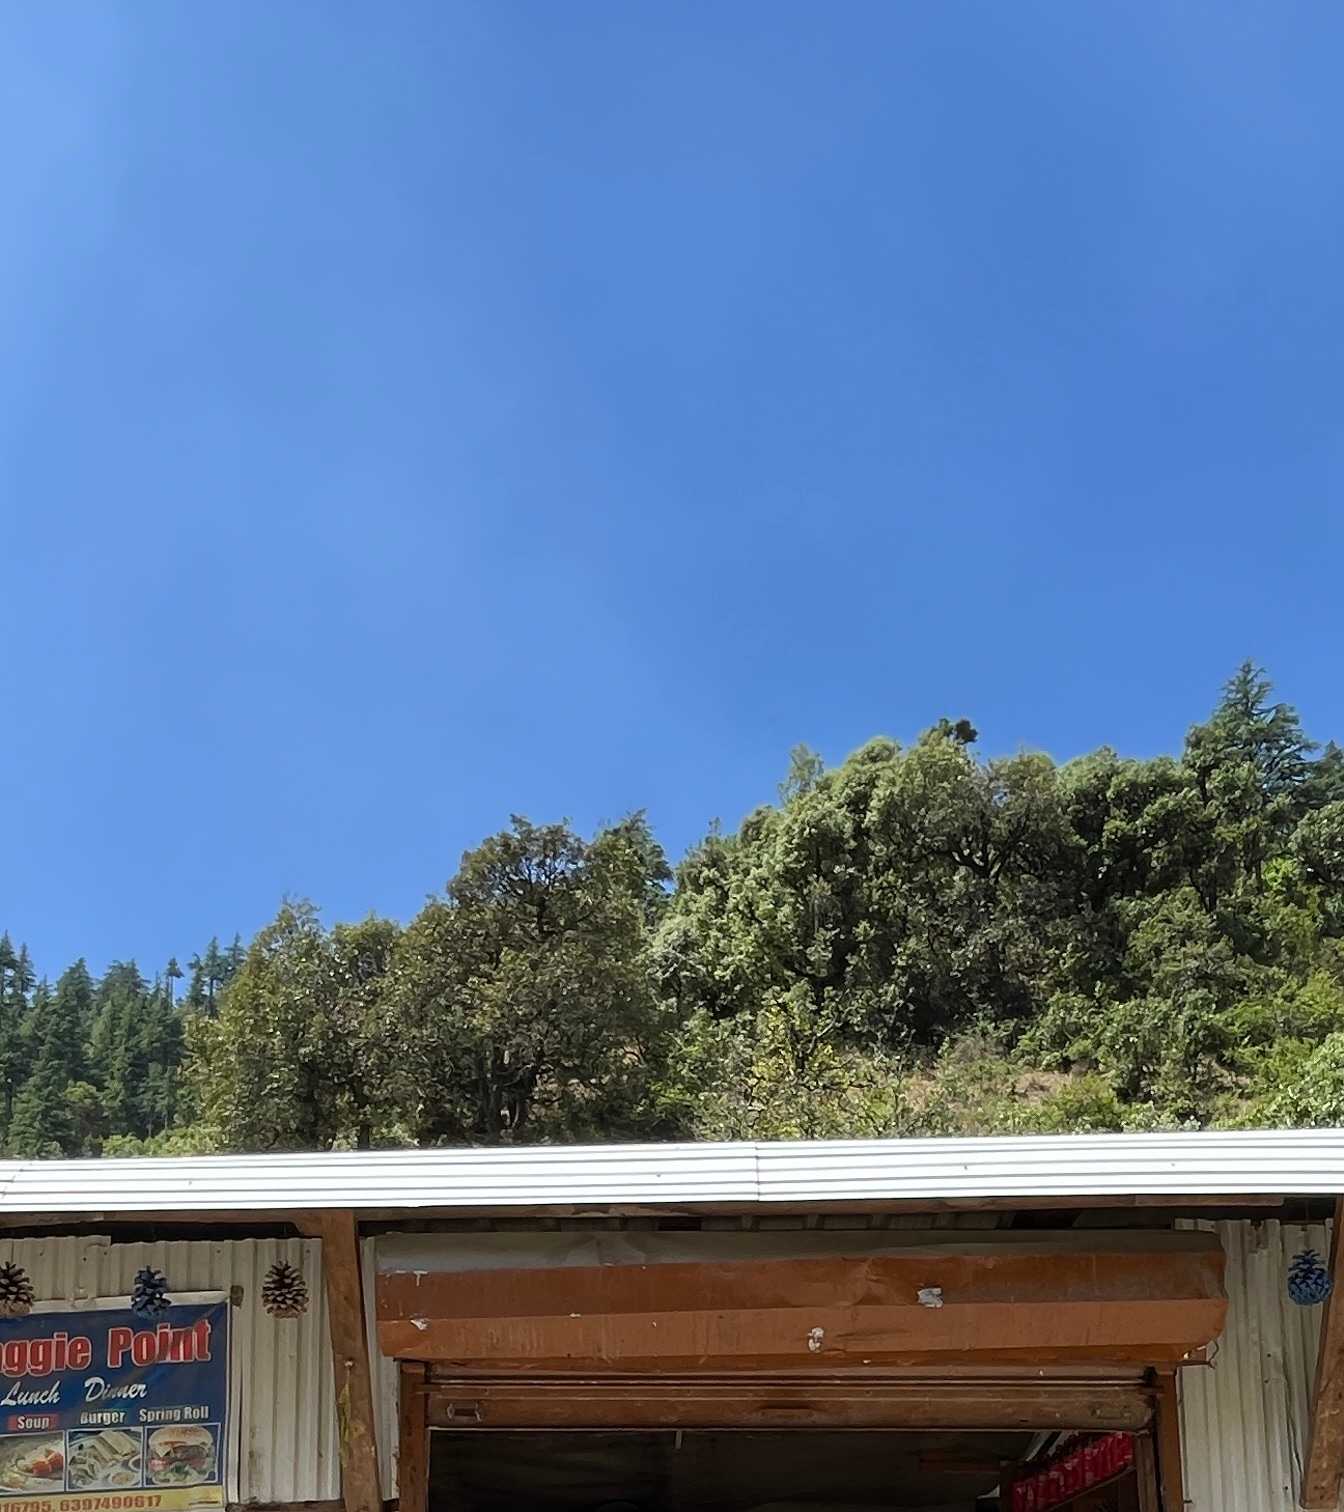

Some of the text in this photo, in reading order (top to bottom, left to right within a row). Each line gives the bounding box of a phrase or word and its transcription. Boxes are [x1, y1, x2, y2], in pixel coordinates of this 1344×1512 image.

[107, 1319, 212, 1368] Point
[0, 1381, 61, 1407] Lunch
[84, 1376, 148, 1402] Dinner
[17, 1415, 50, 1431] Soup
[80, 1409, 126, 1425] Burger
[139, 1408, 181, 1424] Spring
[184, 1406, 209, 1421] Roll
